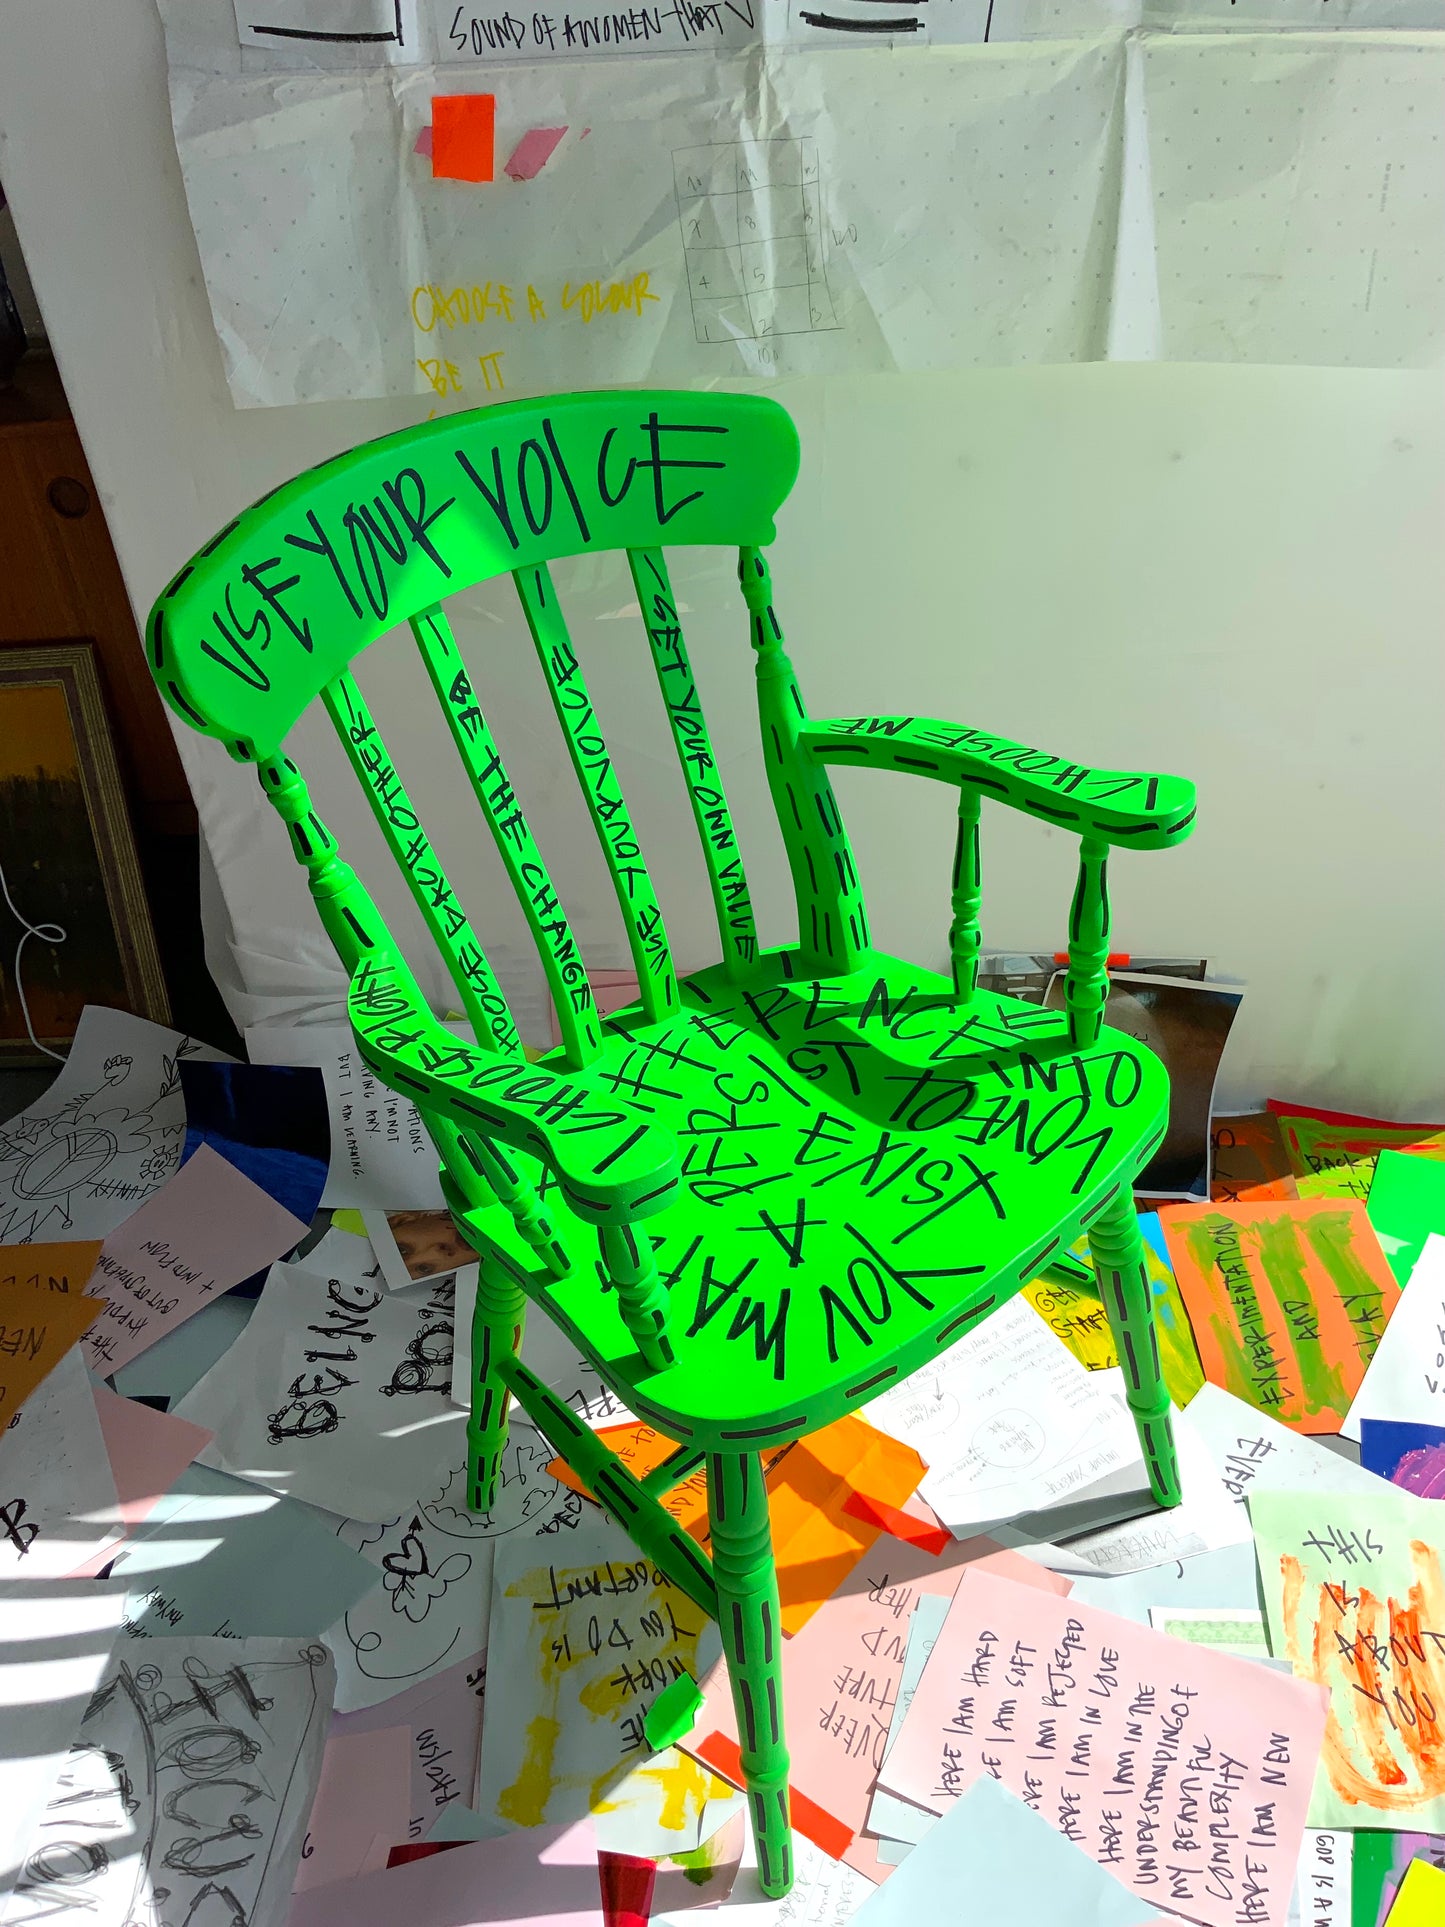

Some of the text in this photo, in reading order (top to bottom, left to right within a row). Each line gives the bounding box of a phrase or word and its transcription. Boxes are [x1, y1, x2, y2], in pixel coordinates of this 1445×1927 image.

[449, 6, 525, 55] SOUND
[532, 12, 557, 50] OF
[411, 281, 515, 332] CHOOSE
[526, 284, 546, 324] A
[416, 357, 463, 399] BE
[200, 411, 730, 693] USE YOUR VOICE
[827, 716, 915, 736] ME
[649, 595, 758, 965] SET YOUR OWN VALUE
[911, 725, 1144, 802] CHOOSE
[550, 642, 669, 974] USE YOUR VOICE
[448, 669, 593, 1014] BE THE CHANGE
[348, 715, 520, 1058] HOOSE EACH OTHER
[350, 960, 426, 1054] RIGHT
[337, 1052, 352, 1079] BUT
[417, 1042, 628, 1136] CHOOSE
[986, 1050, 1143, 1108] INTO
[341, 1103, 354, 1122] AM
[386, 1119, 401, 1143] NOT
[957, 1095, 1115, 1195] LOVE
[818, 1221, 987, 1363] YOU
[1282, 1299, 1323, 1341] AND
[1302, 1524, 1384, 1565] THIS
[532, 1560, 672, 1611] PORTANT
[867, 1574, 914, 1619] HER
[1323, 1579, 1361, 1616] IS
[551, 1601, 697, 1663] YOU DO IS
[960, 1630, 1000, 1688] HARD
[1004, 1639, 1038, 1688] SOFT
[1087, 1645, 1120, 1699] LOVE
[834, 1665, 896, 1711] TURE
[1128, 1681, 1156, 1718] THE
[1351, 1682, 1437, 1731] YOU
[951, 1696, 975, 1730] AM
[991, 1699, 1018, 1732] AM
[1034, 1718, 1058, 1751] AM
[1078, 1705, 1103, 1726] IN
[1123, 1720, 1144, 1743] IN
[930, 1742, 964, 1798] HERE
[1069, 1733, 1094, 1768] AM
[1111, 1749, 1136, 1787] AM
[1259, 1731, 1292, 1788] NEW
[1057, 1785, 1088, 1842] HERE
[1096, 1808, 1126, 1865] HERE
[1204, 1750, 1249, 1902] COMPLEXITY
[1250, 1800, 1278, 1838] AM
[1165, 1864, 1204, 1900] MY
[1234, 1853, 1272, 1925] HERE
[1310, 1873, 1334, 1889] IS
[1313, 1897, 1333, 1912] A
